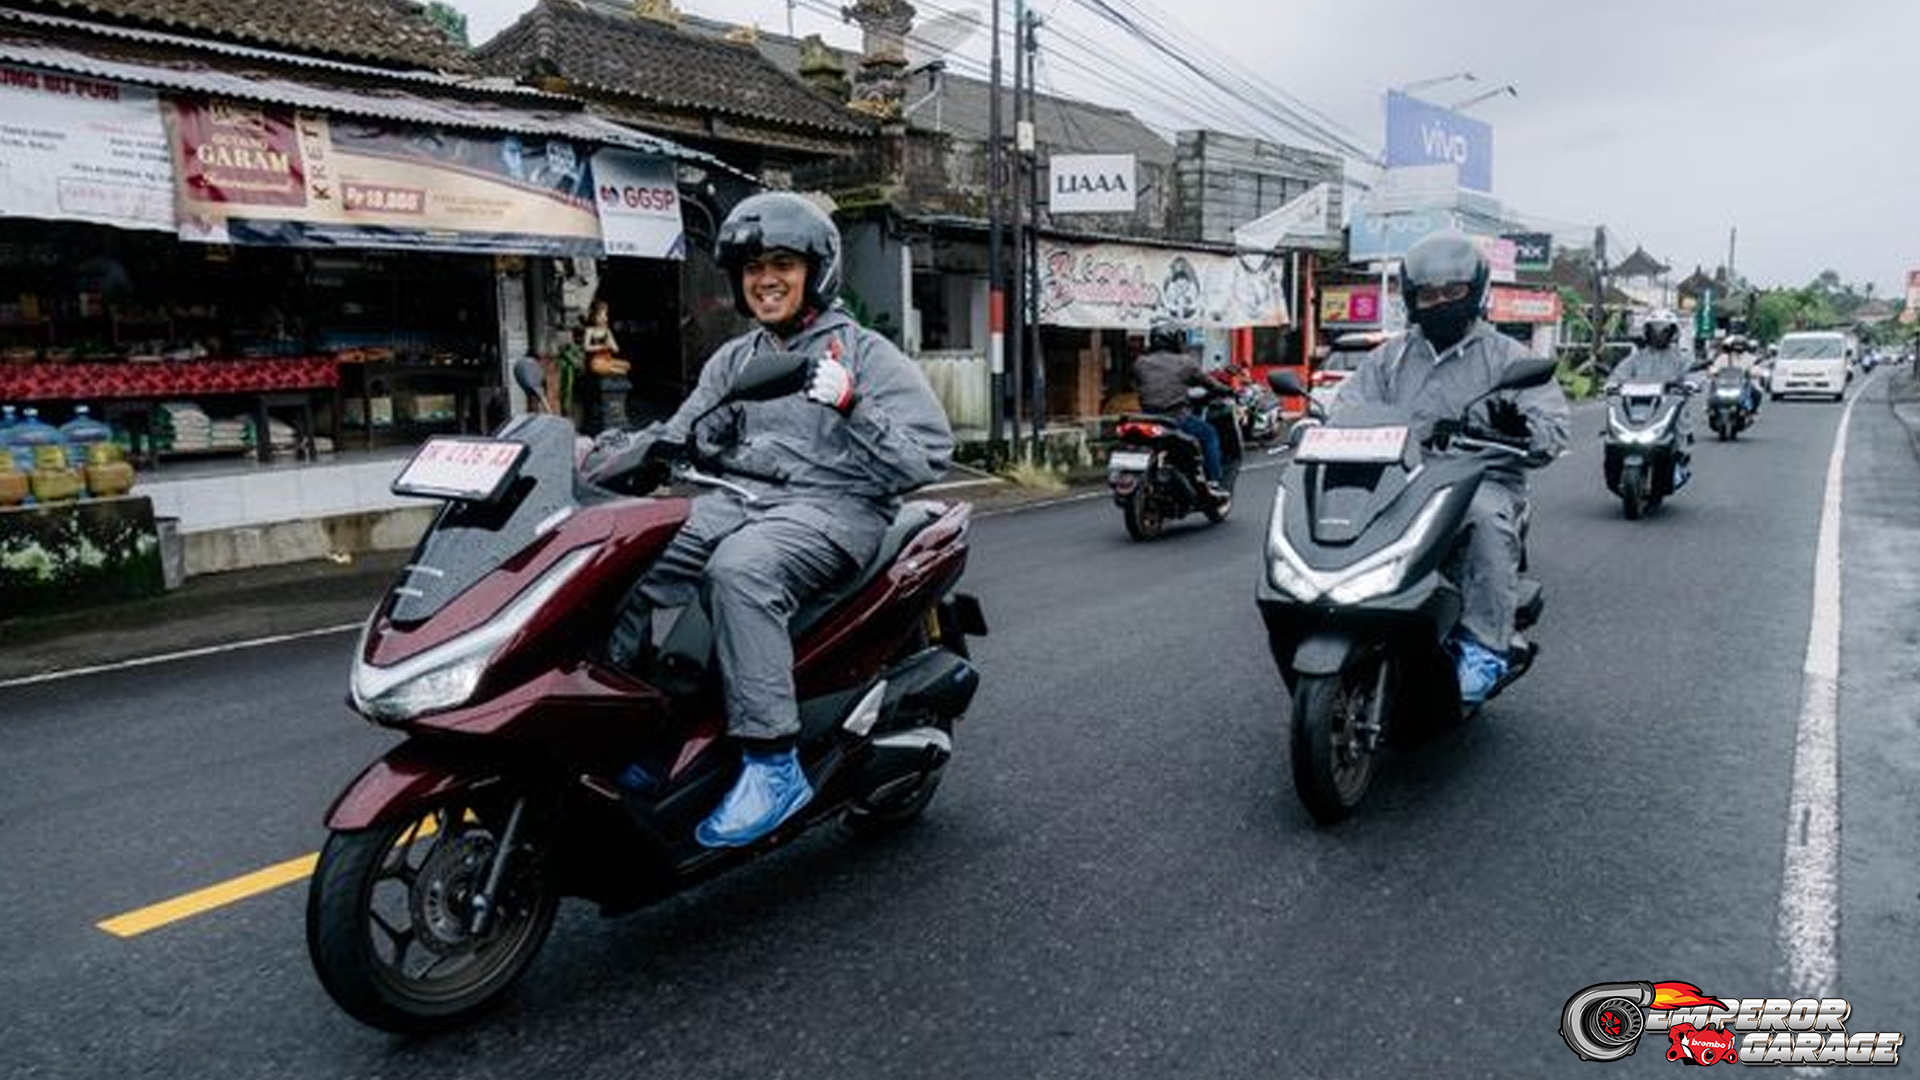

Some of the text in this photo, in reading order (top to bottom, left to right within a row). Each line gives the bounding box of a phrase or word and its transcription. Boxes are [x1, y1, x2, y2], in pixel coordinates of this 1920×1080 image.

[1420, 120, 1467, 165] vivo
[196, 143, 290, 173] GARAM
[1057, 174, 1128, 194] LIAAA
[624, 186, 675, 211] GGSP
